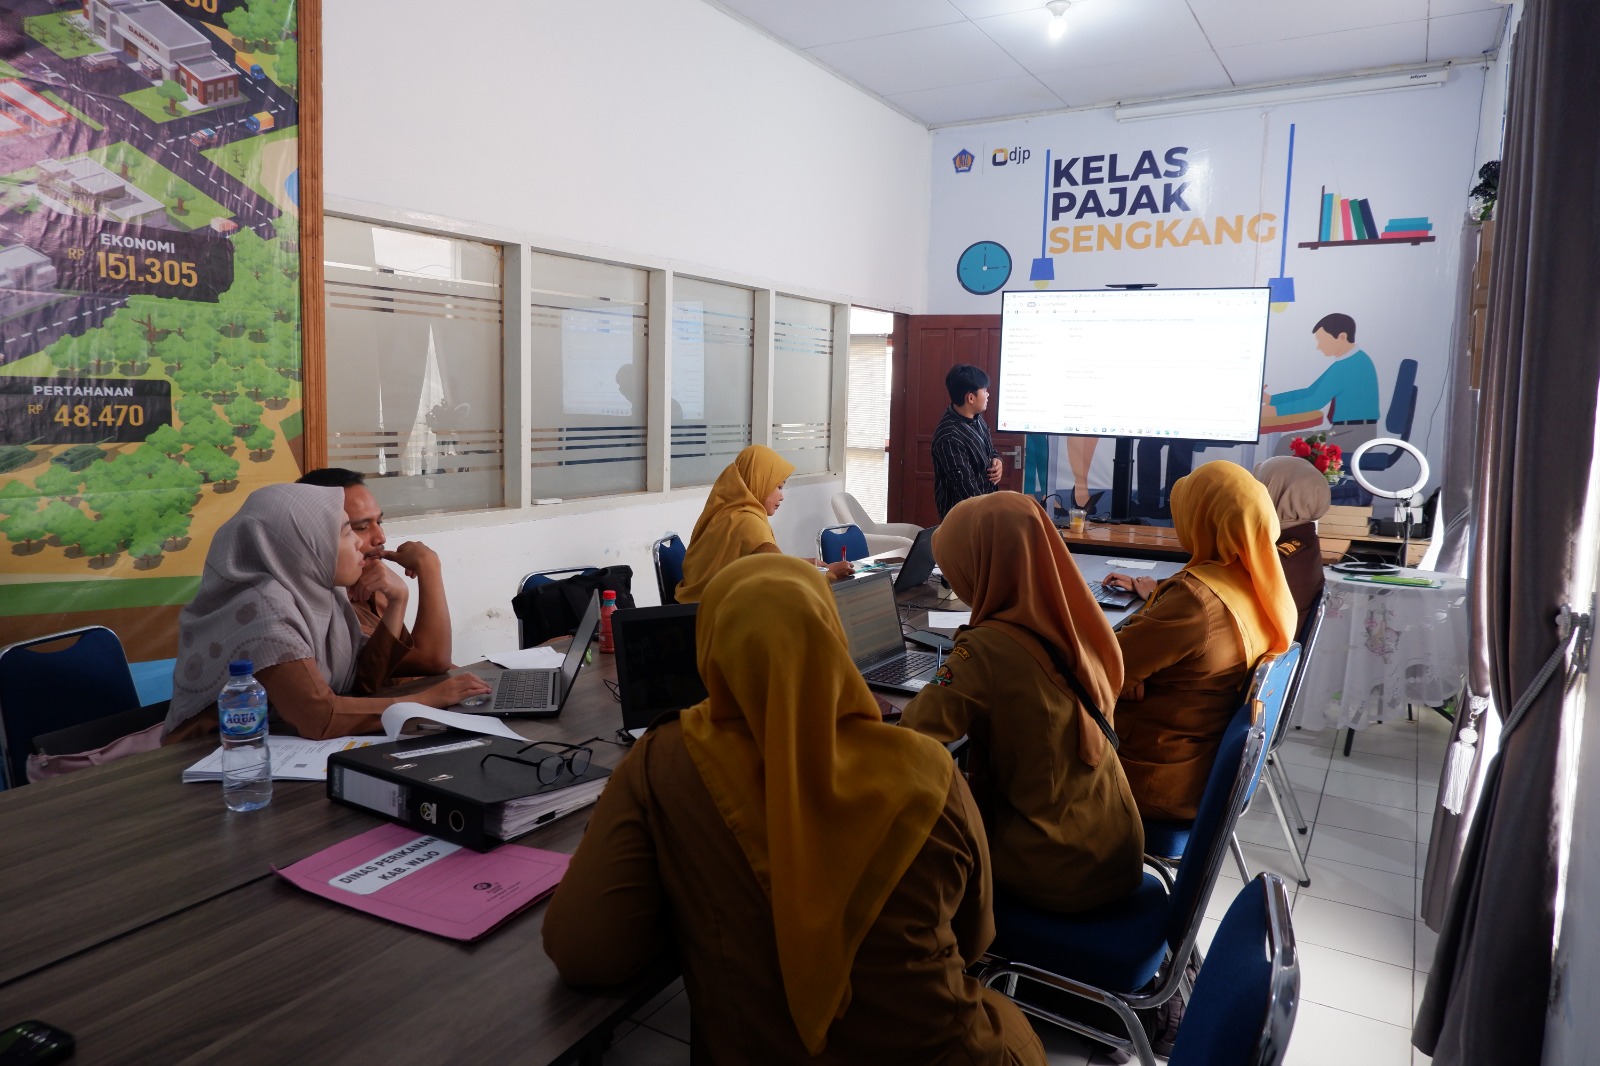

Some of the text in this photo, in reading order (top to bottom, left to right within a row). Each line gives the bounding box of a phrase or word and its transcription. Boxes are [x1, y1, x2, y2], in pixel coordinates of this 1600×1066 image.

[128, 25, 160, 52] DAMKAR
[1008, 146, 1031, 165] djp
[1053, 146, 1189, 188] KELAS
[1051, 181, 1191, 221] PAJAK
[100, 233, 175, 254] EKONOMI
[1048, 212, 1277, 255] SENGKANG
[97, 251, 198, 287] 151.305
[33, 385, 134, 397] PERTAHANAN
[54, 404, 144, 427] 48.470
[226, 712, 257, 725] AQUA
[339, 837, 438, 884] DINAS PERIKANAN
[378, 850, 440, 881] KAB. WAJO
